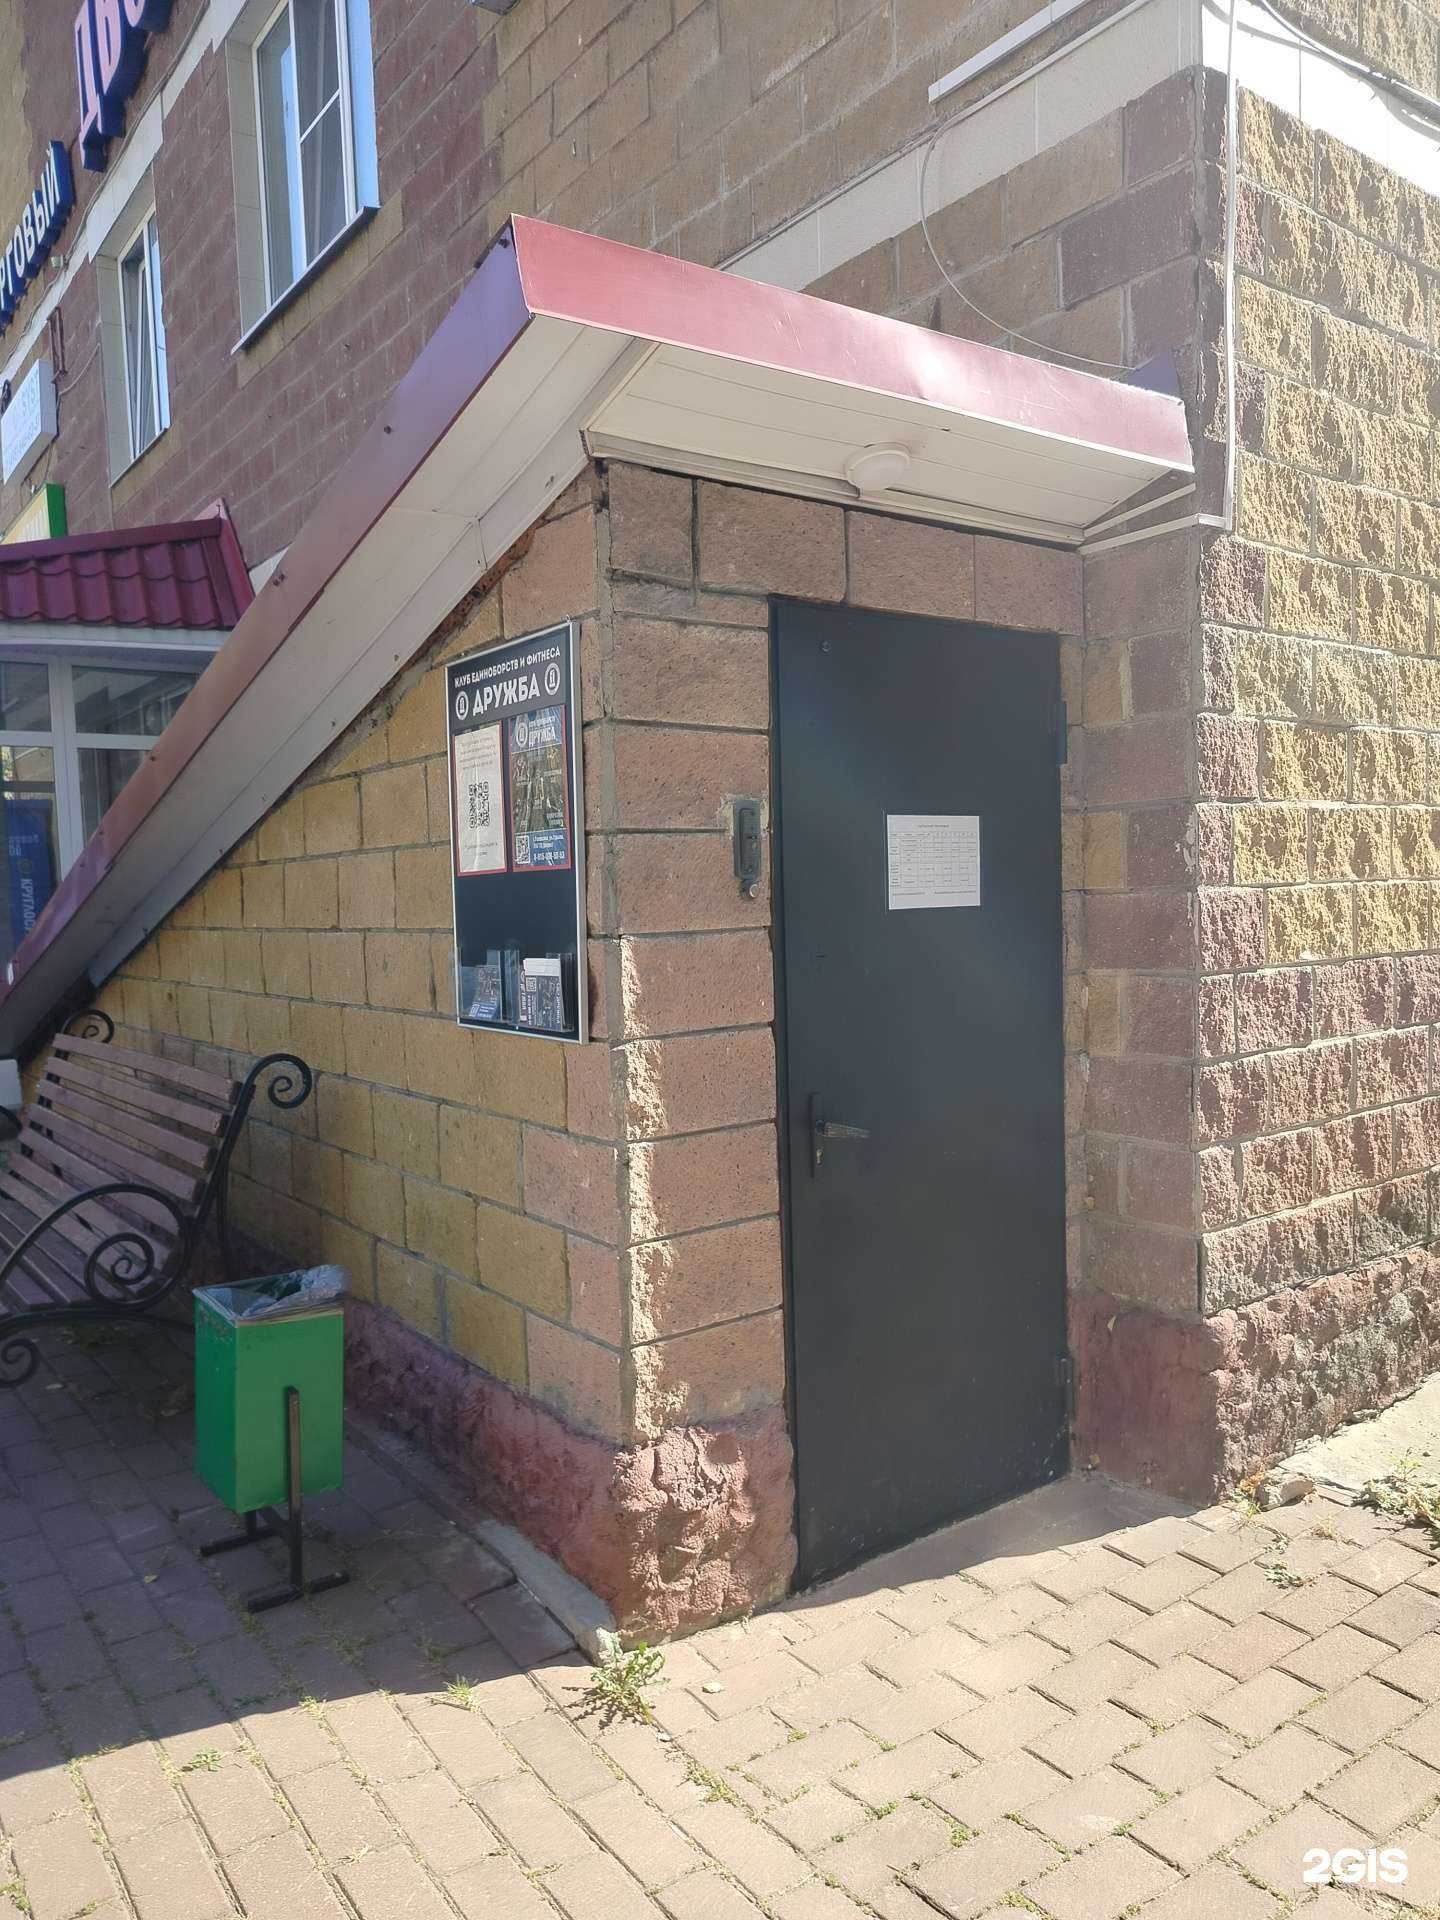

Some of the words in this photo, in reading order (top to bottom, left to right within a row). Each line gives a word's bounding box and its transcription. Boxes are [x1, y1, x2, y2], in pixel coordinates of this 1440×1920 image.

[454, 672, 471, 688] КЛУБ
[471, 659, 519, 683] ЕДИНОБОРСТВ
[519, 657, 526, 668] И
[526, 645, 561, 665] ФИТНЕСА
[472, 672, 541, 717] ДРУЖБА
